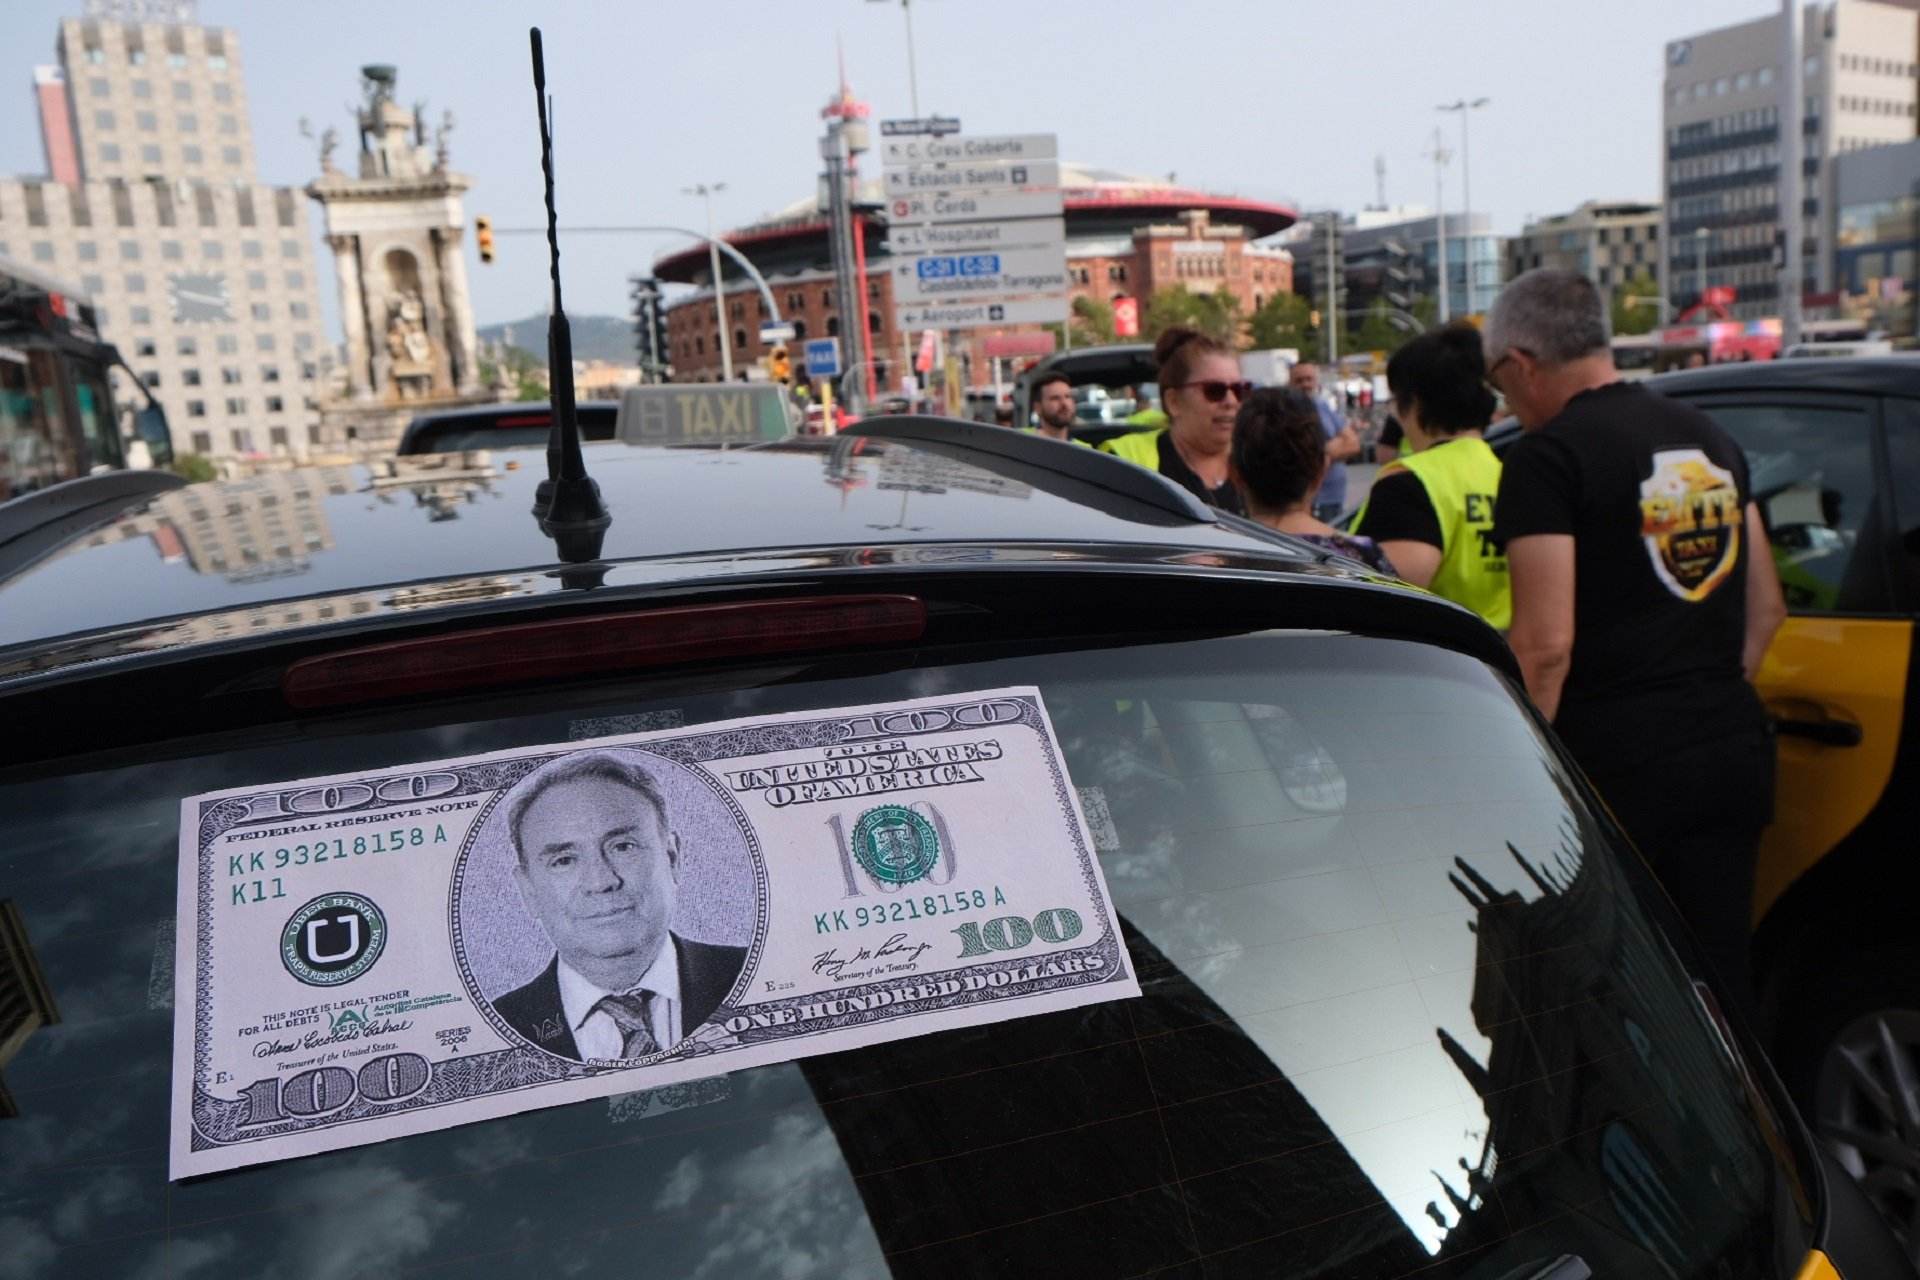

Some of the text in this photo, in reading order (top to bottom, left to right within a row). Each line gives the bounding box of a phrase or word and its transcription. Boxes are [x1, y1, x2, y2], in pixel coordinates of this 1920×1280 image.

[675, 394, 753, 434] TAXI
[840, 702, 1022, 741] 100
[724, 739, 1003, 792] UNITED STATES
[764, 763, 985, 808] OF AMERICA
[234, 772, 460, 824] 100
[225, 799, 480, 844] FEDERAL RESERVE NOTE
[229, 823, 448, 877] KK 93218158 A
[232, 877, 288, 906] K11
[813, 884, 1007, 934] KK 93218158 A
[289, 901, 329, 936] UBER
[950, 907, 1083, 959] 100
[309, 966, 357, 982] RESERVE
[725, 953, 1105, 1034] ONE HUNDRED DOLLARS
[238, 1014, 320, 1038] FOR ALL DEBTS
[262, 989, 410, 1024] THIS NOTE IS LEGAL TENDER
[435, 1025, 472, 1040] SERIES
[236, 1052, 434, 1129] 100
